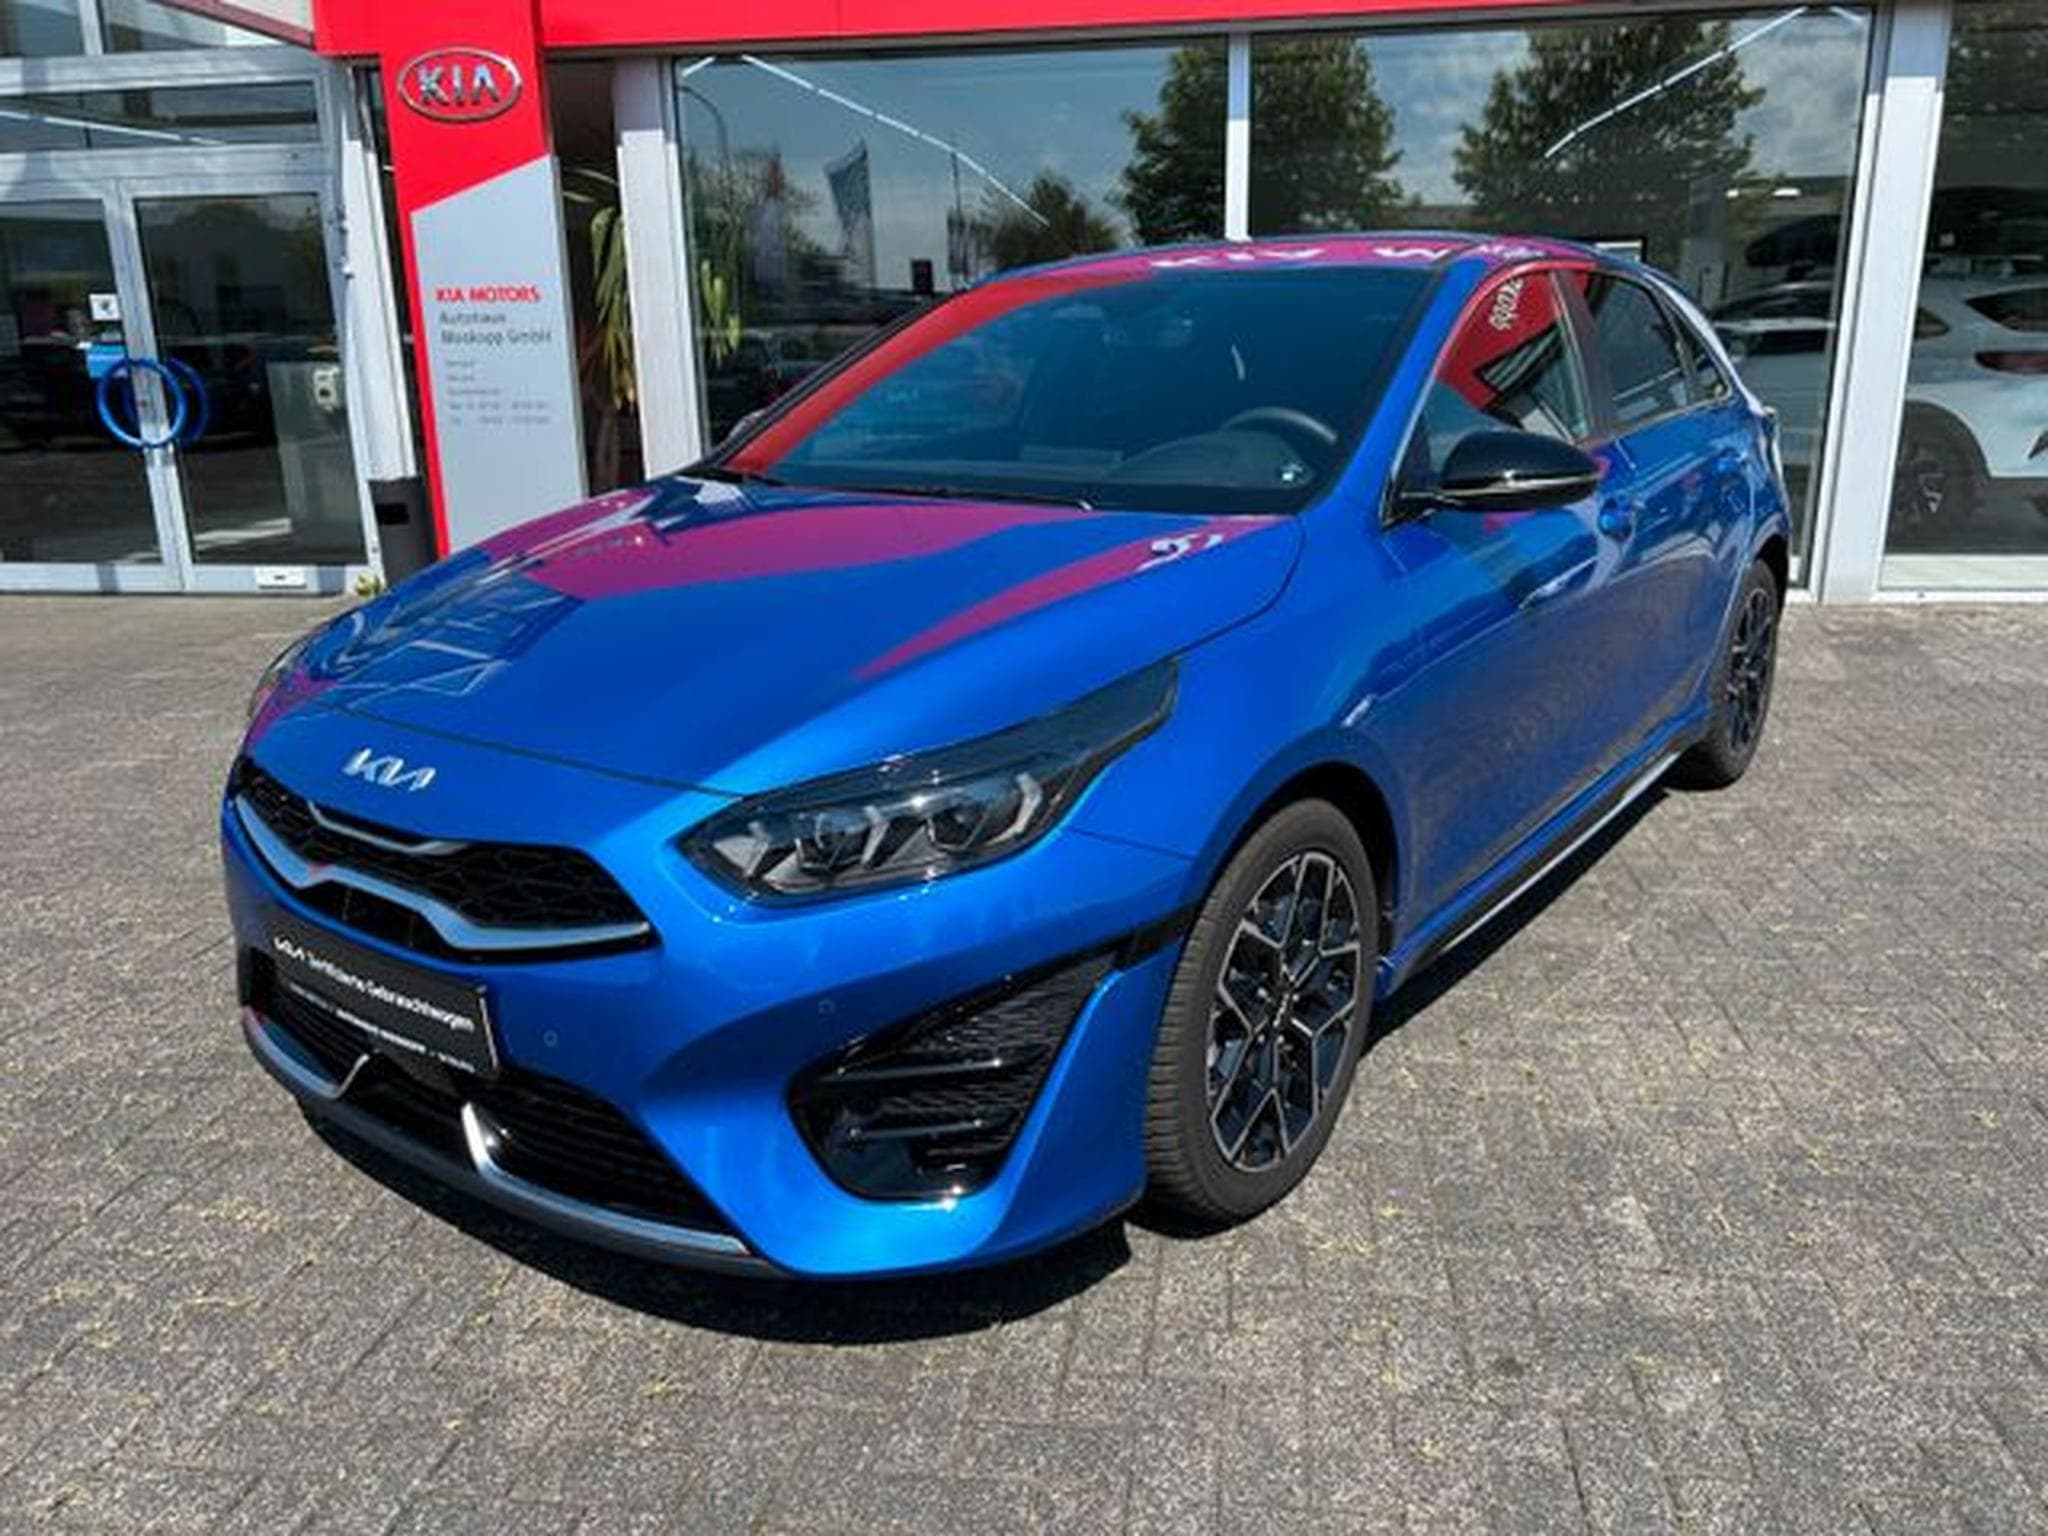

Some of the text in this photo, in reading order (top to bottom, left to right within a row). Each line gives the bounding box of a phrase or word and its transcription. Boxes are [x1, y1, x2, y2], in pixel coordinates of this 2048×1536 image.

[416, 63, 500, 106] KIA
[436, 285, 541, 302] KIA MOTORS
[440, 309, 506, 324] Autohaus
[506, 328, 553, 344] GmbH
[342, 747, 437, 791] KIA
